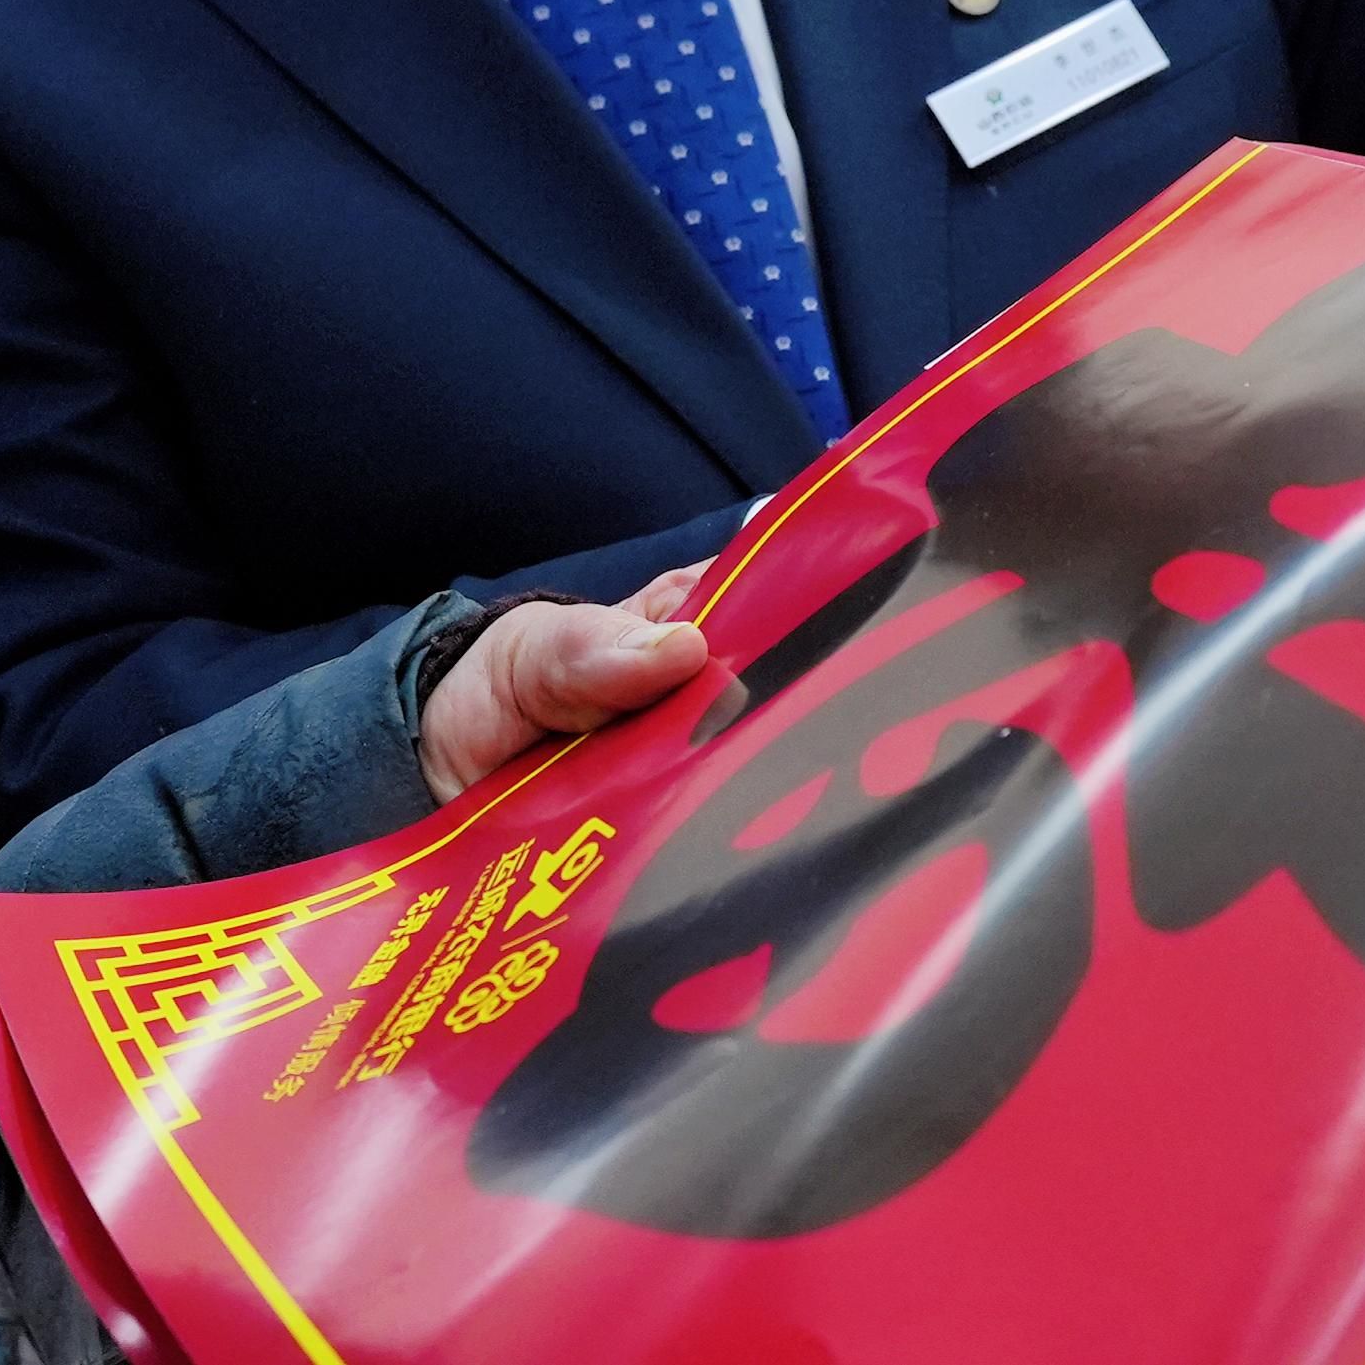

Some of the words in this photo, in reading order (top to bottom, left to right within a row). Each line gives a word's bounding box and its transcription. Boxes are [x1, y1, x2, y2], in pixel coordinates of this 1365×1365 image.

[347, 885, 450, 990] 无界金融
[356, 837, 535, 1081] 运城农商银行
